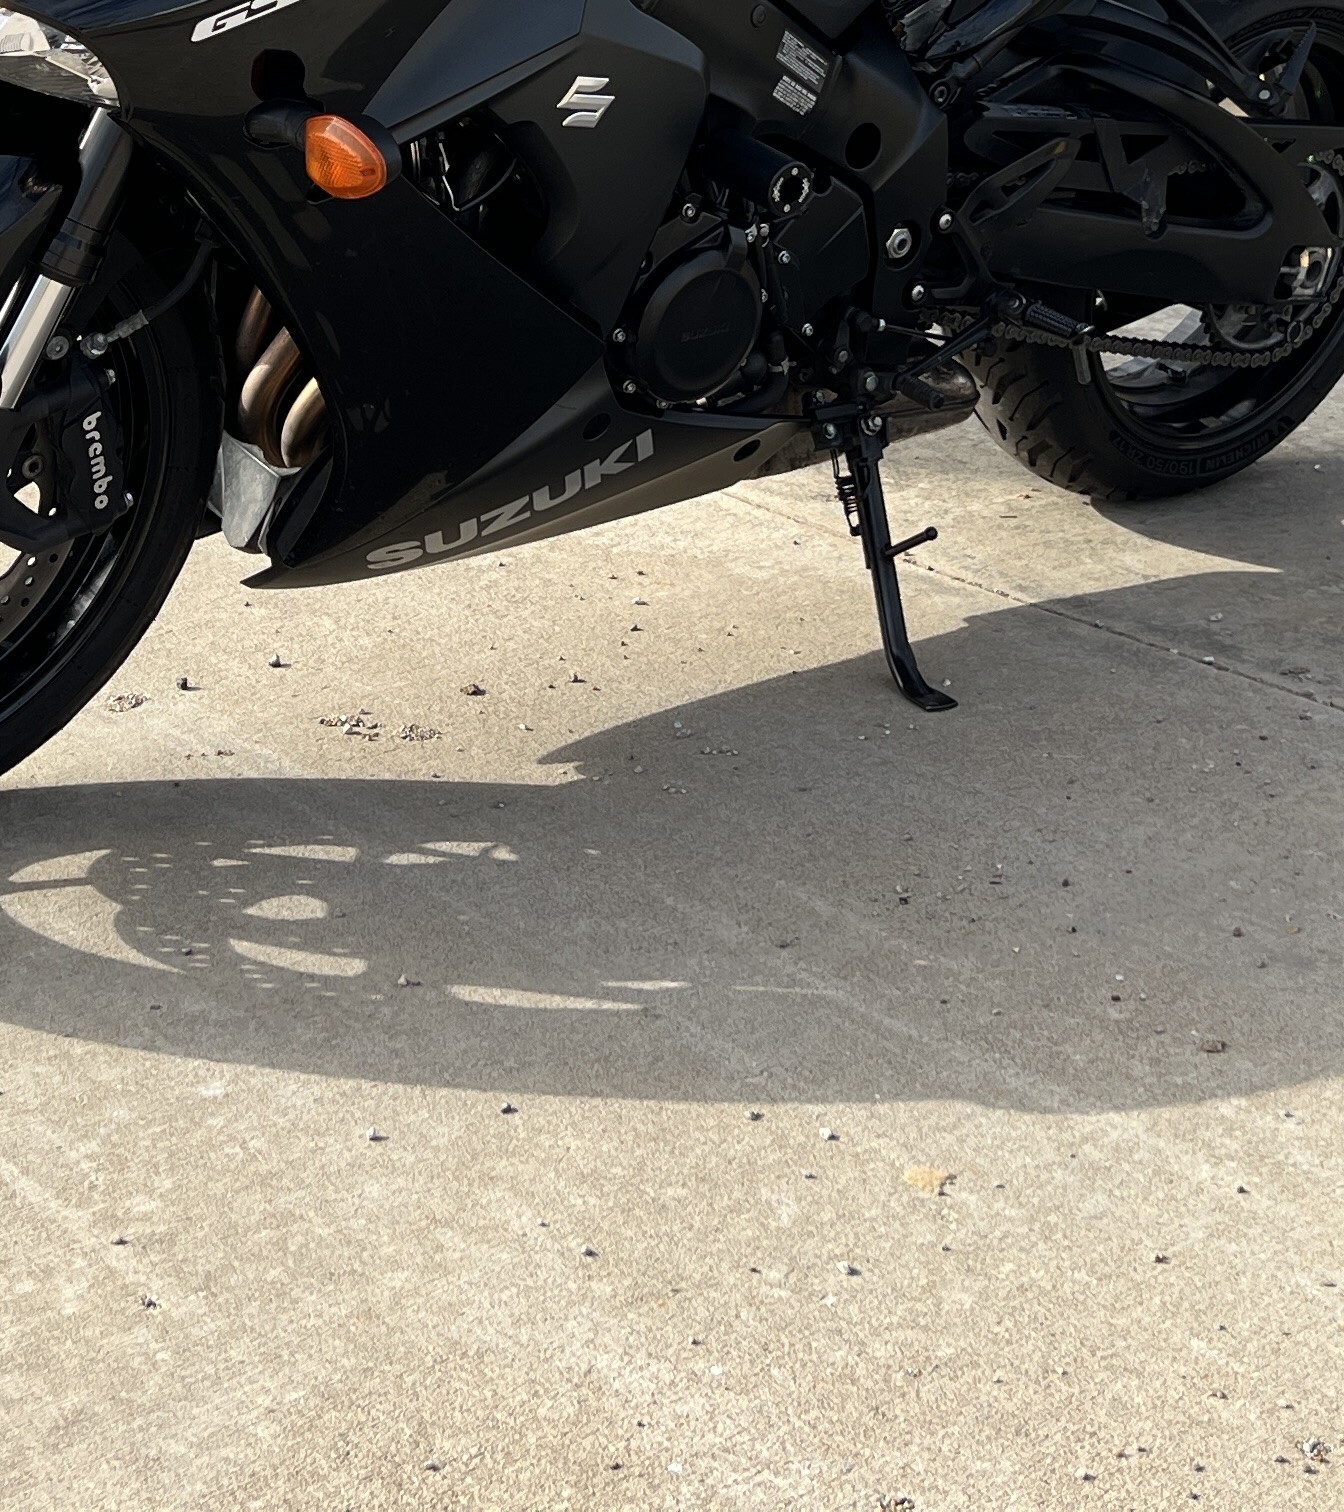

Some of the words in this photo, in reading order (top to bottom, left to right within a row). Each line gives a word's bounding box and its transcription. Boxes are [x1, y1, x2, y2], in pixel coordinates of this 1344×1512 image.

[82, 411, 113, 509] brembo
[366, 428, 654, 569] SUZUKI
[1145, 455, 1194, 474] 190/50
